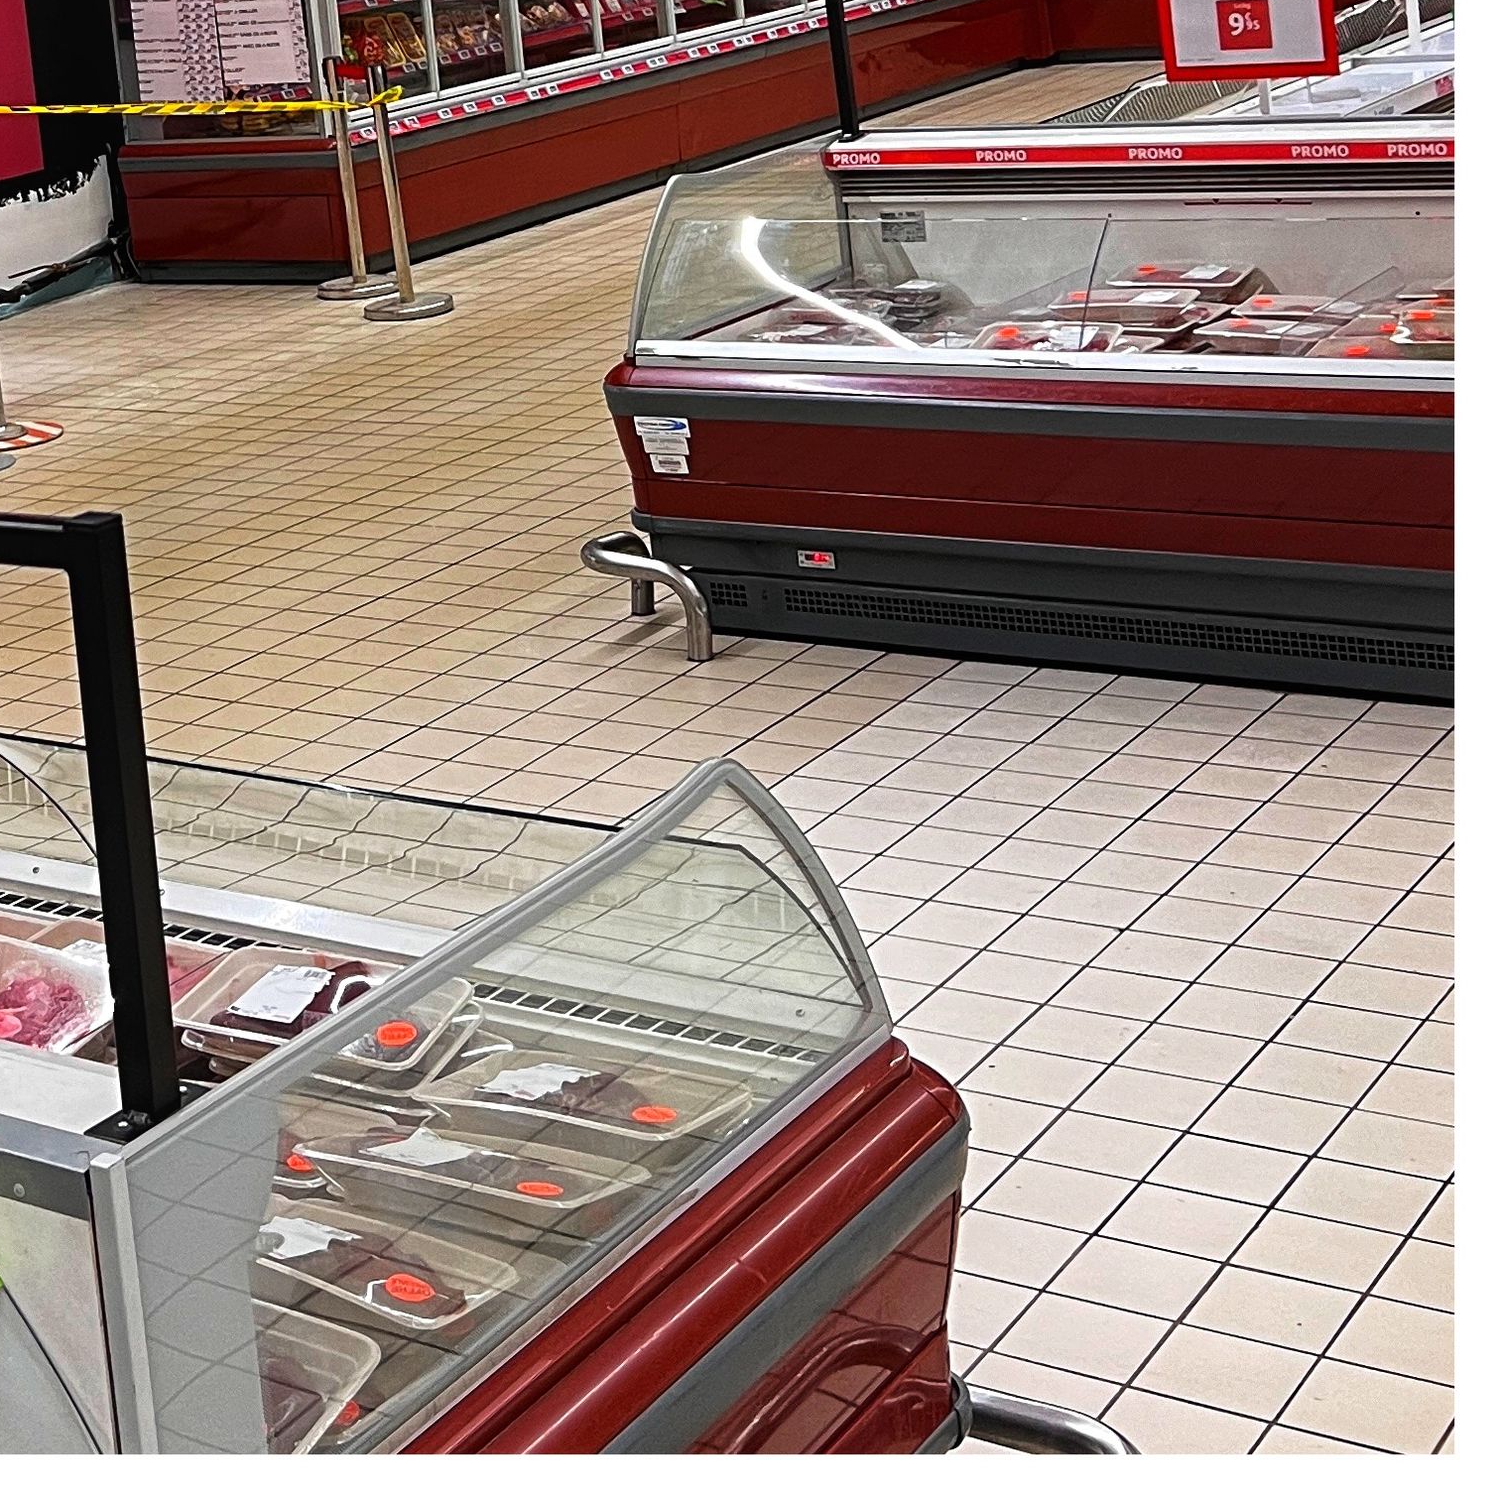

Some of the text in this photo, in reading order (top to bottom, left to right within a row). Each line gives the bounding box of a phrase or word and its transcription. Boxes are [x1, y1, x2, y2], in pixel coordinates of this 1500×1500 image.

[975, 149, 1027, 162] PROMO
[1128, 147, 1183, 160] PROMO
[1291, 144, 1349, 159] PROMO
[1387, 142, 1448, 158] PROMO
[832, 152, 881, 165] PROMO
